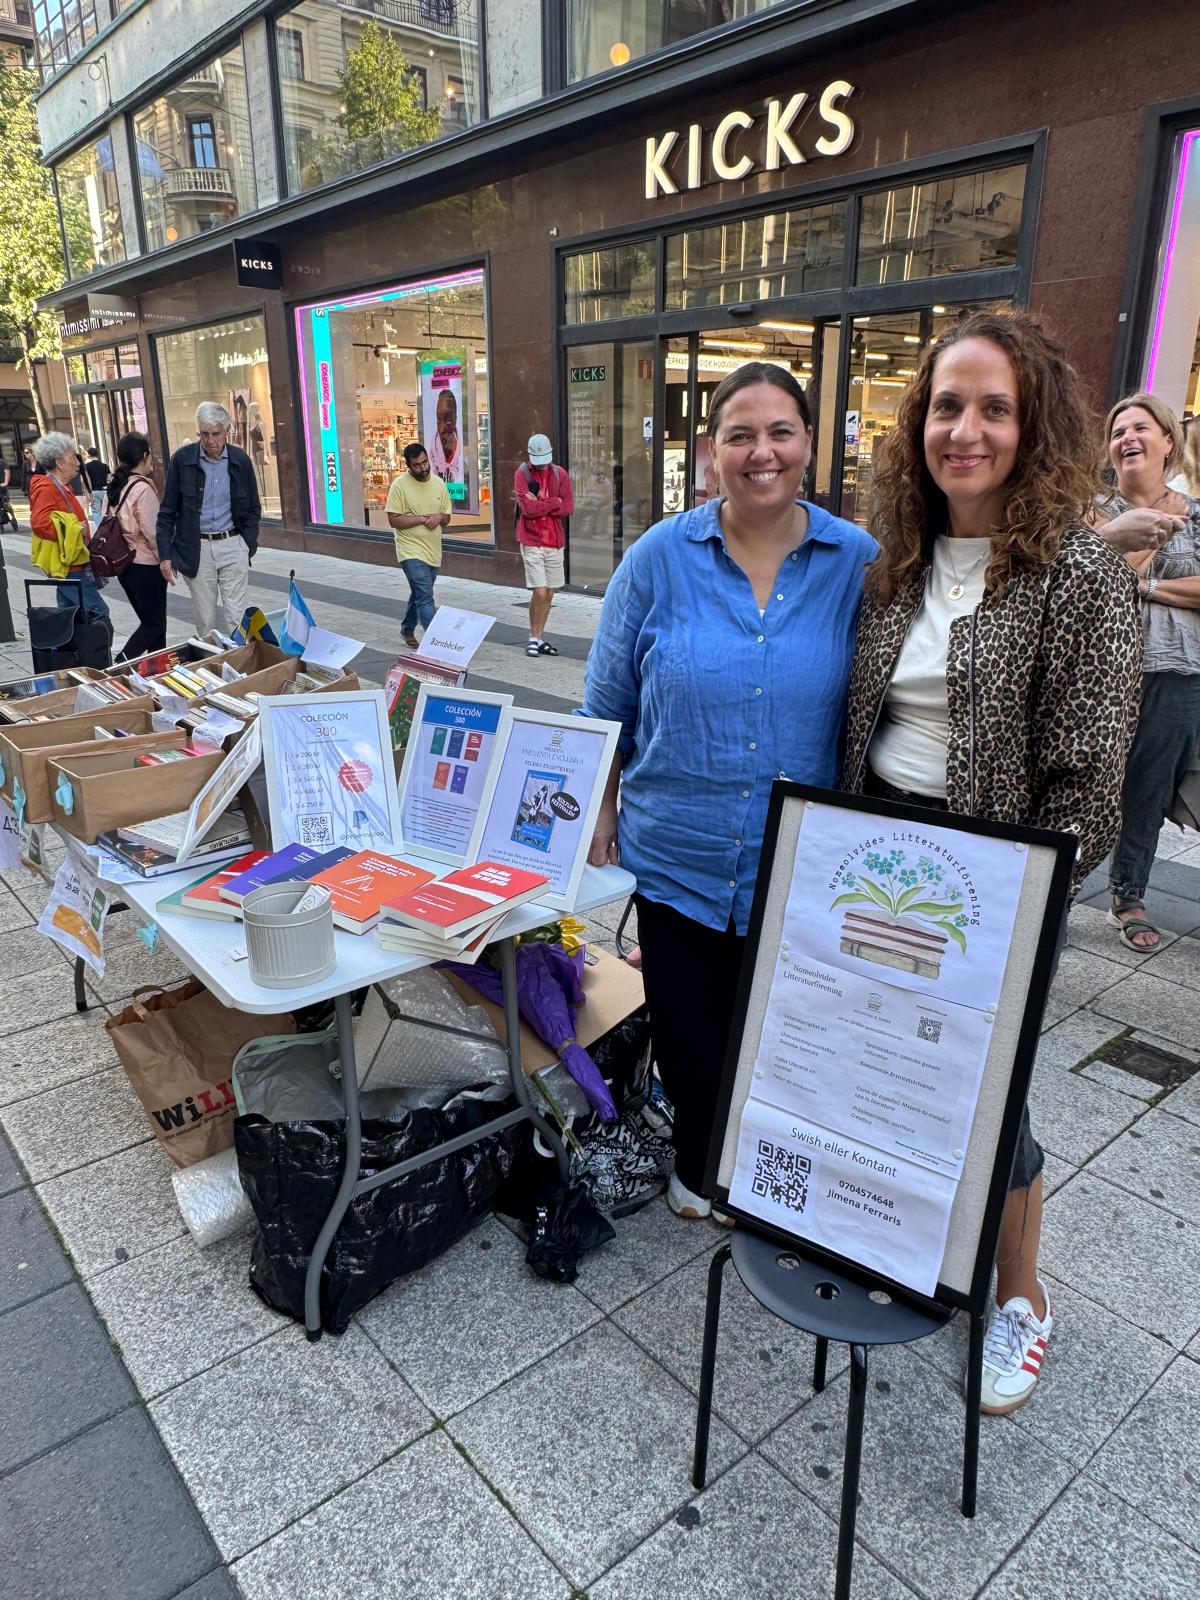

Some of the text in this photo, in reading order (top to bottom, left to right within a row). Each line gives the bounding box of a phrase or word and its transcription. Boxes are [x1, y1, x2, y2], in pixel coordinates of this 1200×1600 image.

[645, 80, 855, 199] KICKS
[241, 258, 273, 271] KICKS
[571, 367, 605, 382] KICKS
[326, 452, 338, 491] KICKS
[430, 637, 465, 652] Barnböcker
[300, 712, 349, 723] COLECCIÓN
[444, 704, 483, 718] COLECCIÓN
[453, 716, 466, 724] 300
[315, 726, 337, 737] 300
[521, 748, 551, 760] PREVENTA
[551, 797, 576, 818] FESTIVALEN
[828, 832, 982, 926] Nomeolvides Litteraturförening
[793, 963, 836, 983] Nomeolvides
[783, 970, 843, 997] Litteraturförening
[921, 1061, 941, 1072] genom
[152, 1078, 236, 1132] WiLL
[854, 1093, 865, 1101] con
[871, 1090, 879, 1098] de
[901, 1102, 921, 1114] Mejora
[790, 1127, 821, 1148] Swish
[824, 1140, 850, 1159] eller
[851, 1150, 898, 1178] Kontant
[838, 1180, 895, 1209] 0704574648
[826, 1188, 902, 1226] Jimena Ferraris
